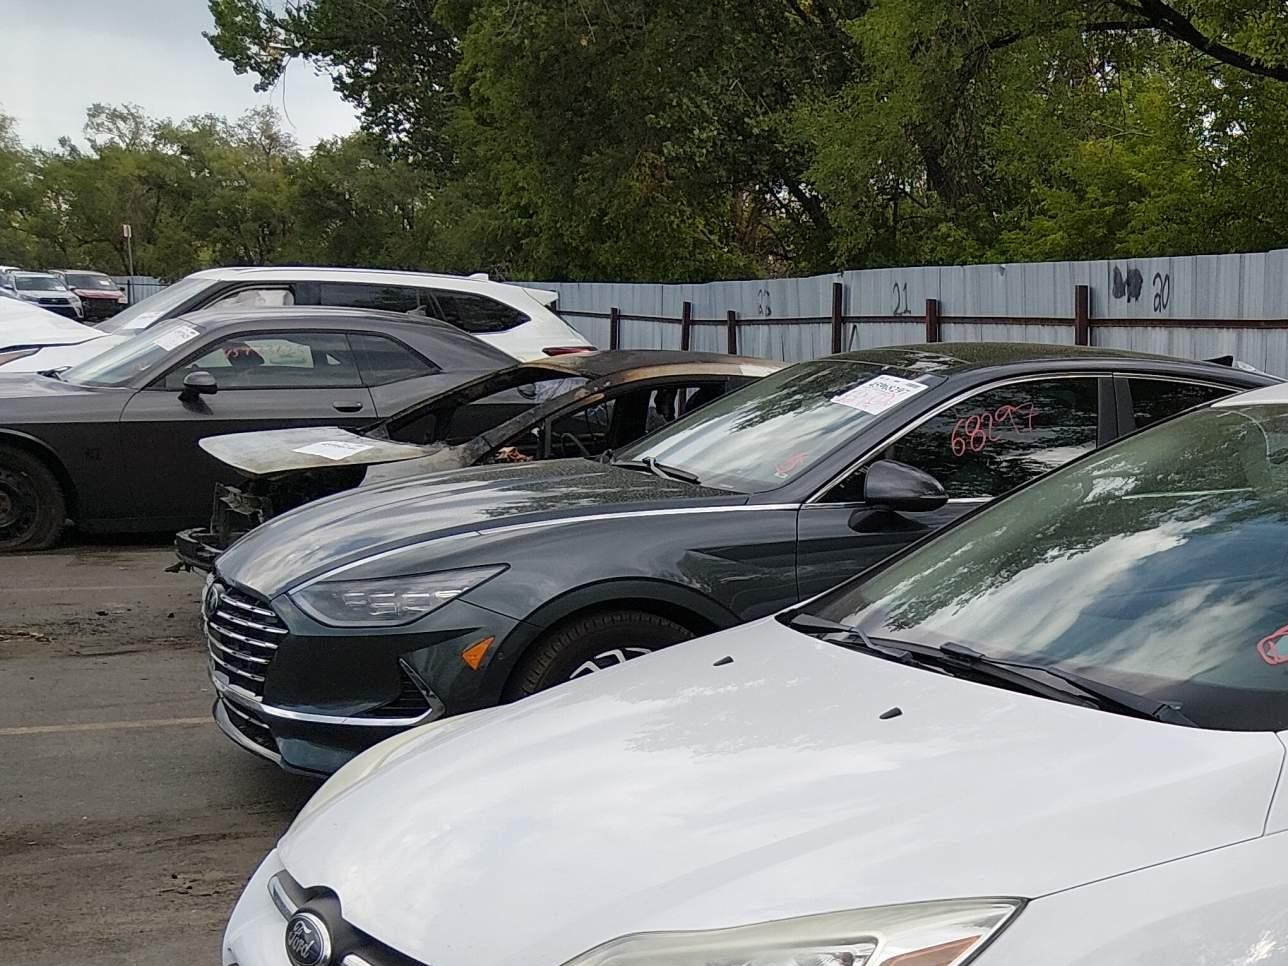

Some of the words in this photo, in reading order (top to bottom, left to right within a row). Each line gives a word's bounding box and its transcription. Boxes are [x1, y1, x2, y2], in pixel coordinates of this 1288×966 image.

[892, 282, 911, 316] 21
[1152, 272, 1170, 313] 20
[951, 402, 1040, 457] 68297
[287, 919, 316, 959] Ford
